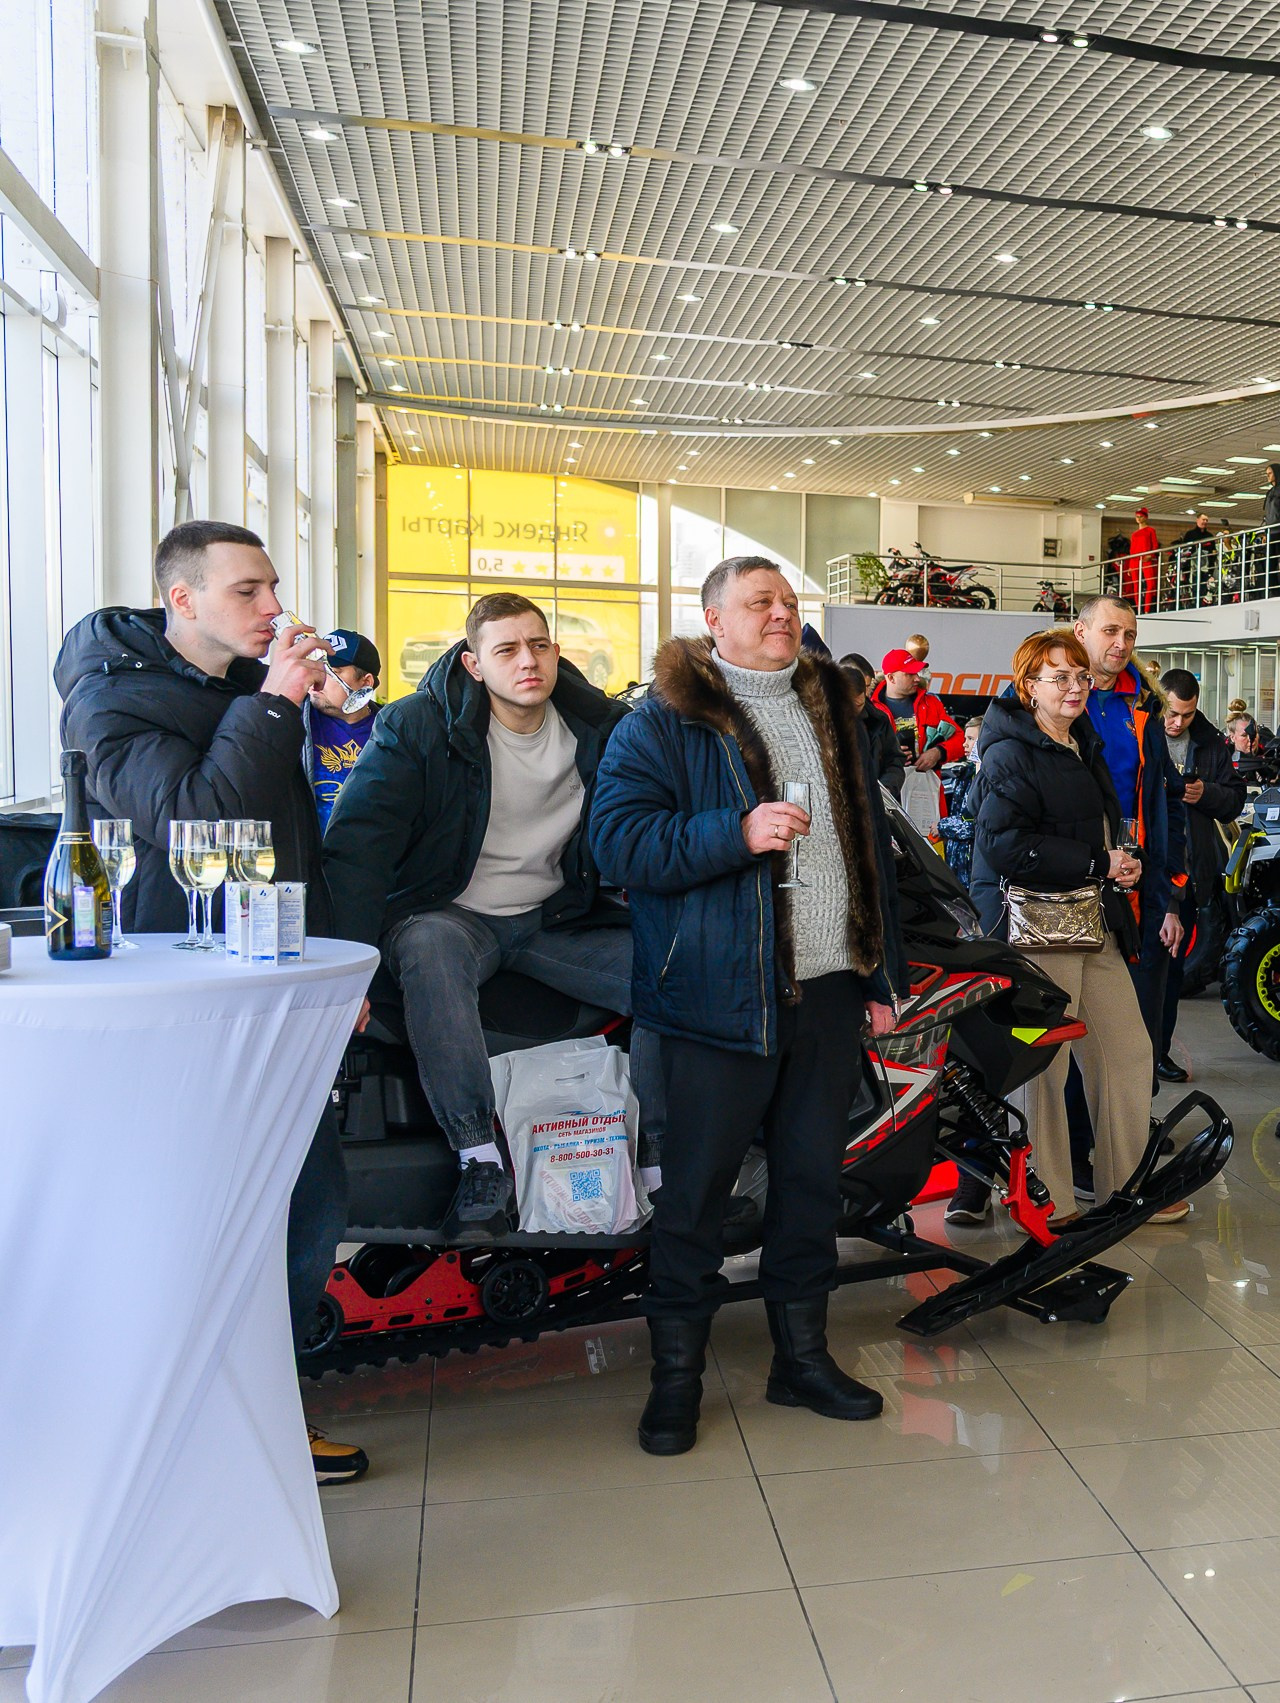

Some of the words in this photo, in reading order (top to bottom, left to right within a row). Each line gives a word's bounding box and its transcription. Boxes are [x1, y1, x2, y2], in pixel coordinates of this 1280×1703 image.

[532, 1117, 588, 1135] АКТИВНЫЙ
[592, 1115, 626, 1126] ОТДЫХ
[573, 1127, 606, 1135] МАГАЗИНОВ
[550, 1147, 614, 1162] 8-800-500-30-31
